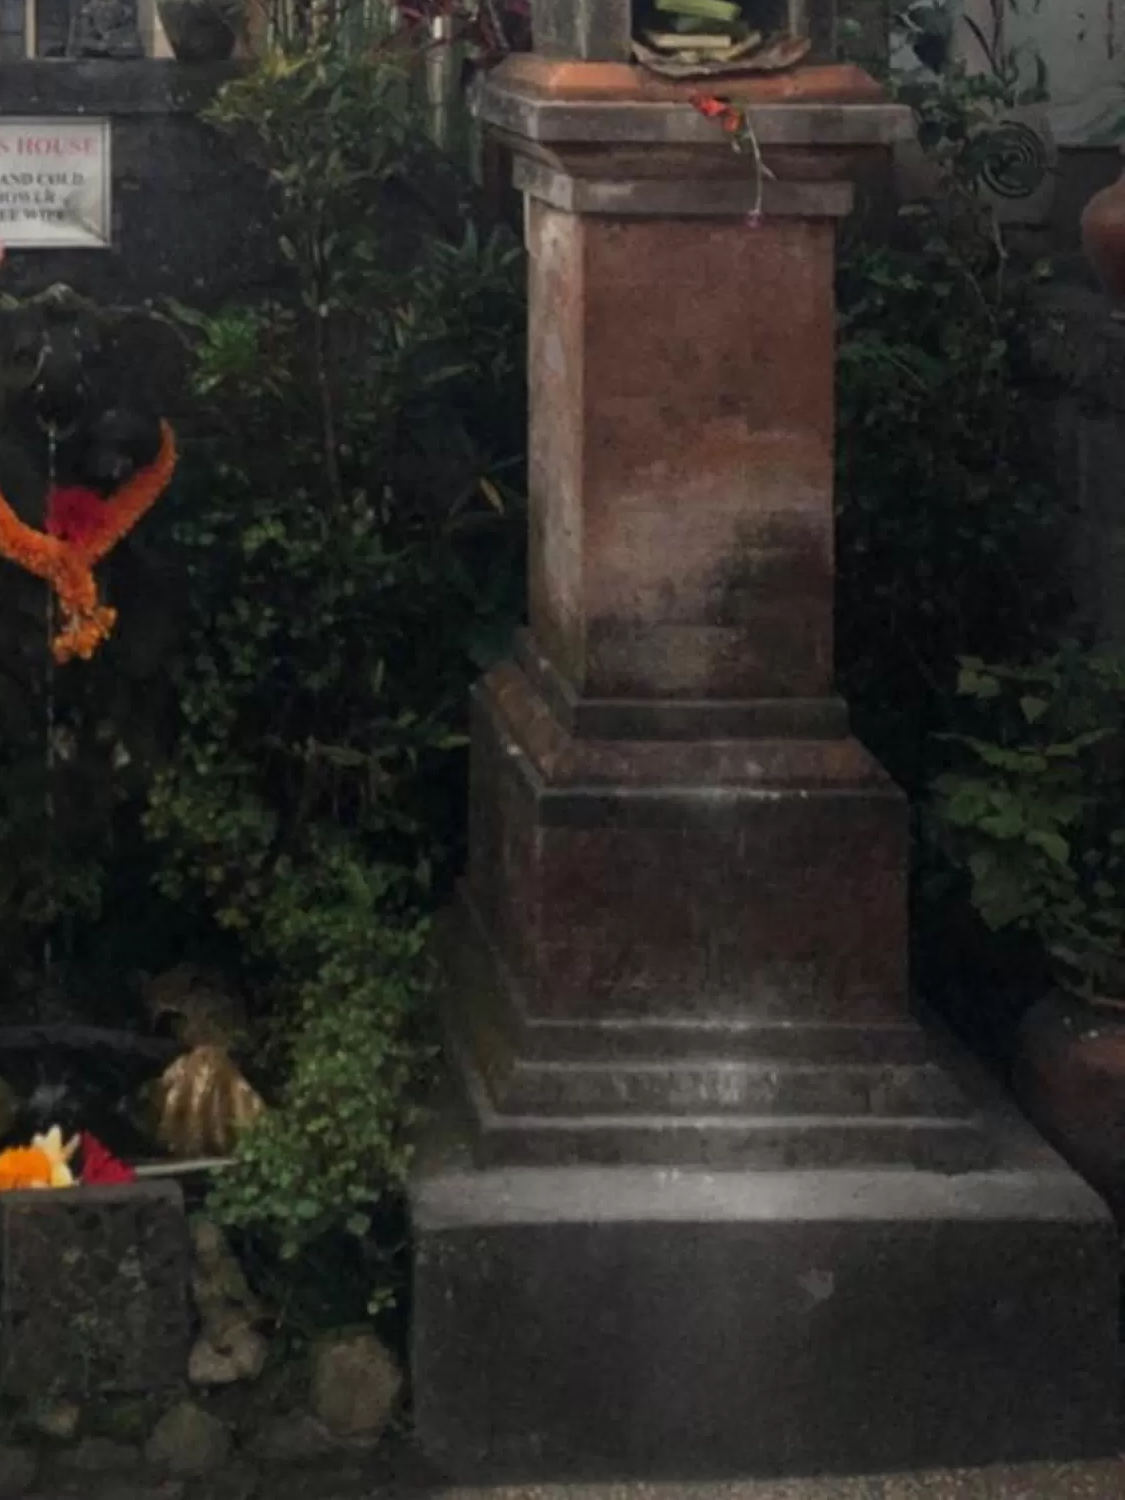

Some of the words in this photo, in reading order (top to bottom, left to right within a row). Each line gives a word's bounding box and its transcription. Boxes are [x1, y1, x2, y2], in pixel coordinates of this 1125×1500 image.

[17, 136, 95, 156] HOUSE
[0, 171, 34, 187] AND
[35, 171, 85, 187] COLD
